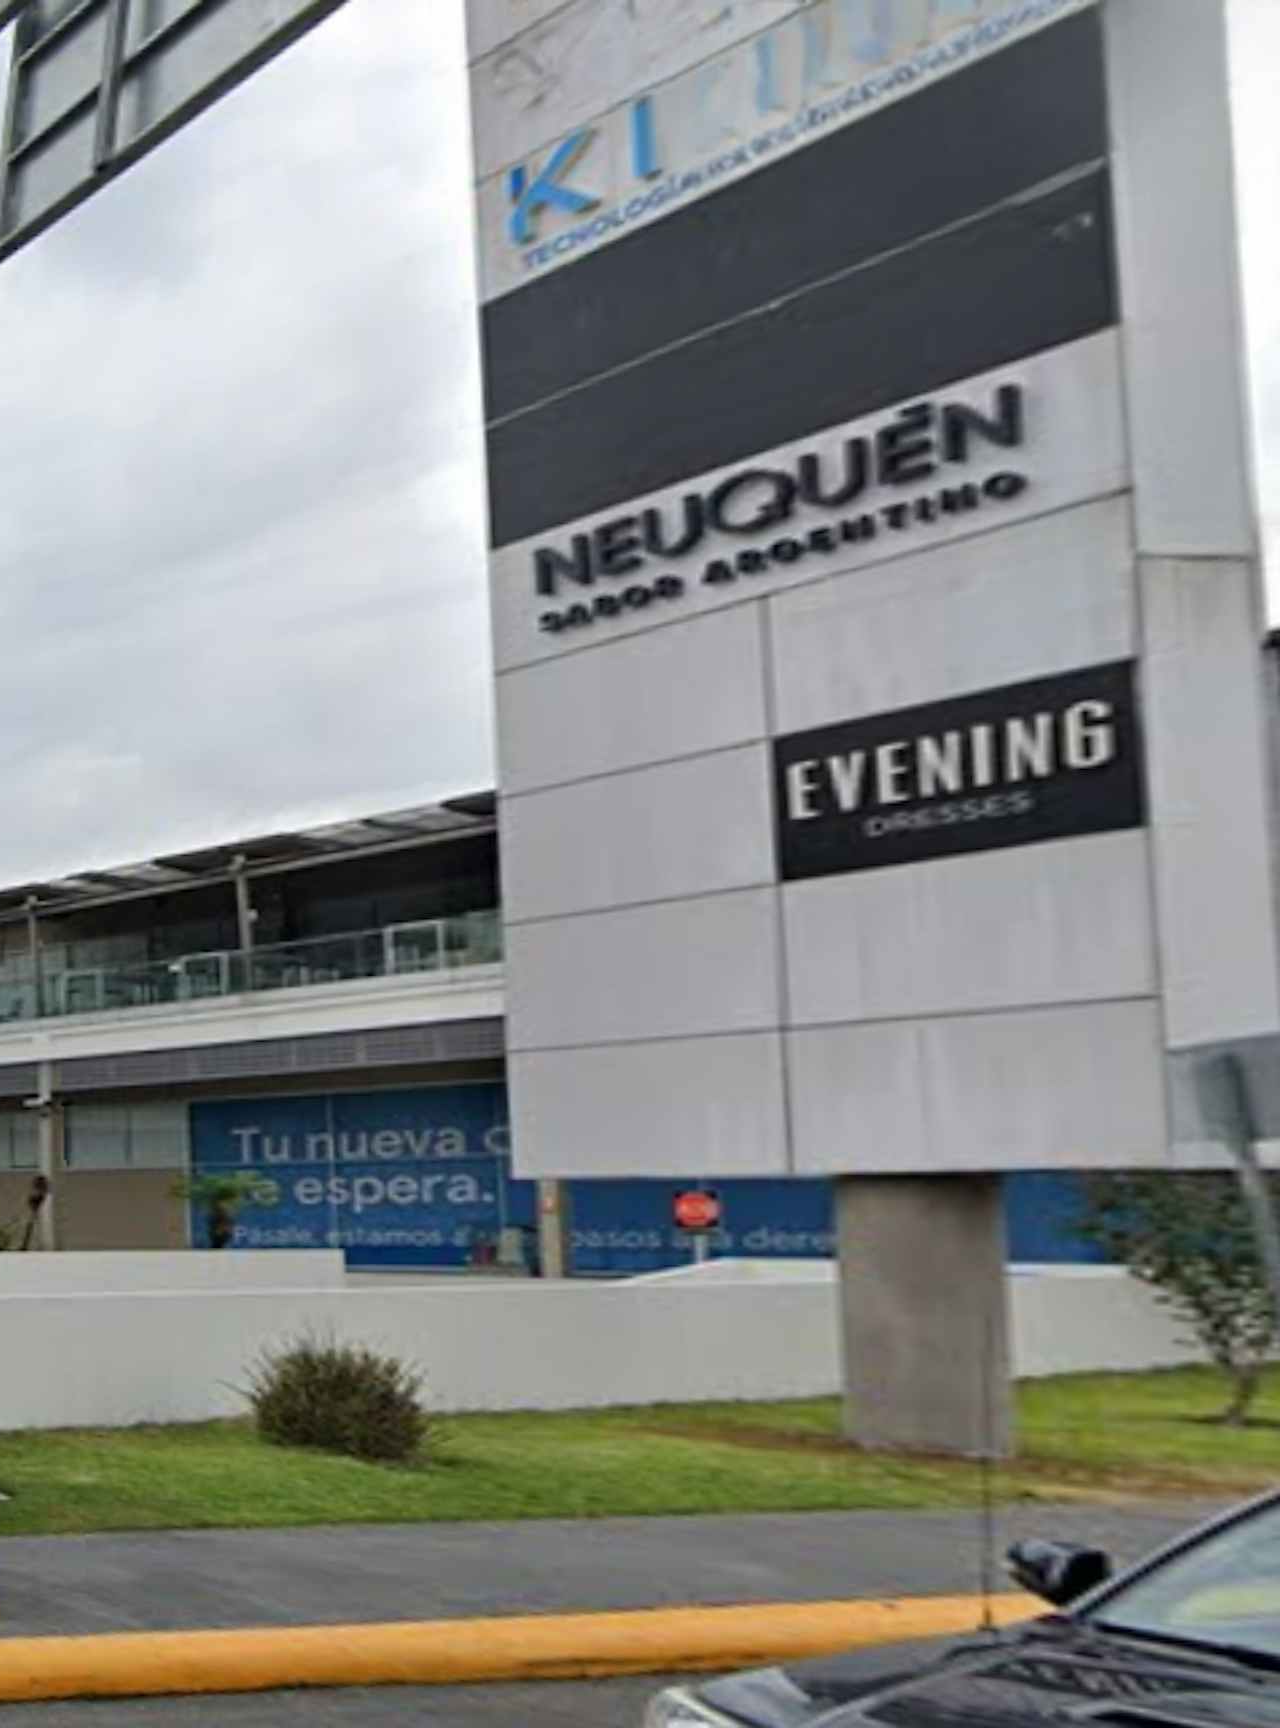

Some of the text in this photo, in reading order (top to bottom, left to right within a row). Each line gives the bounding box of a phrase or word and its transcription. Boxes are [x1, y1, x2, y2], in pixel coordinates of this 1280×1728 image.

[534, 384, 1024, 596] NEUQUÉN
[538, 471, 1028, 635] SABOR ARGENTINO
[786, 699, 1117, 821] EVENING
[863, 790, 1034, 838] DRESSES
[231, 1126, 290, 1164] Tu
[305, 1125, 467, 1162] nueva
[293, 1172, 495, 1213] espera.
